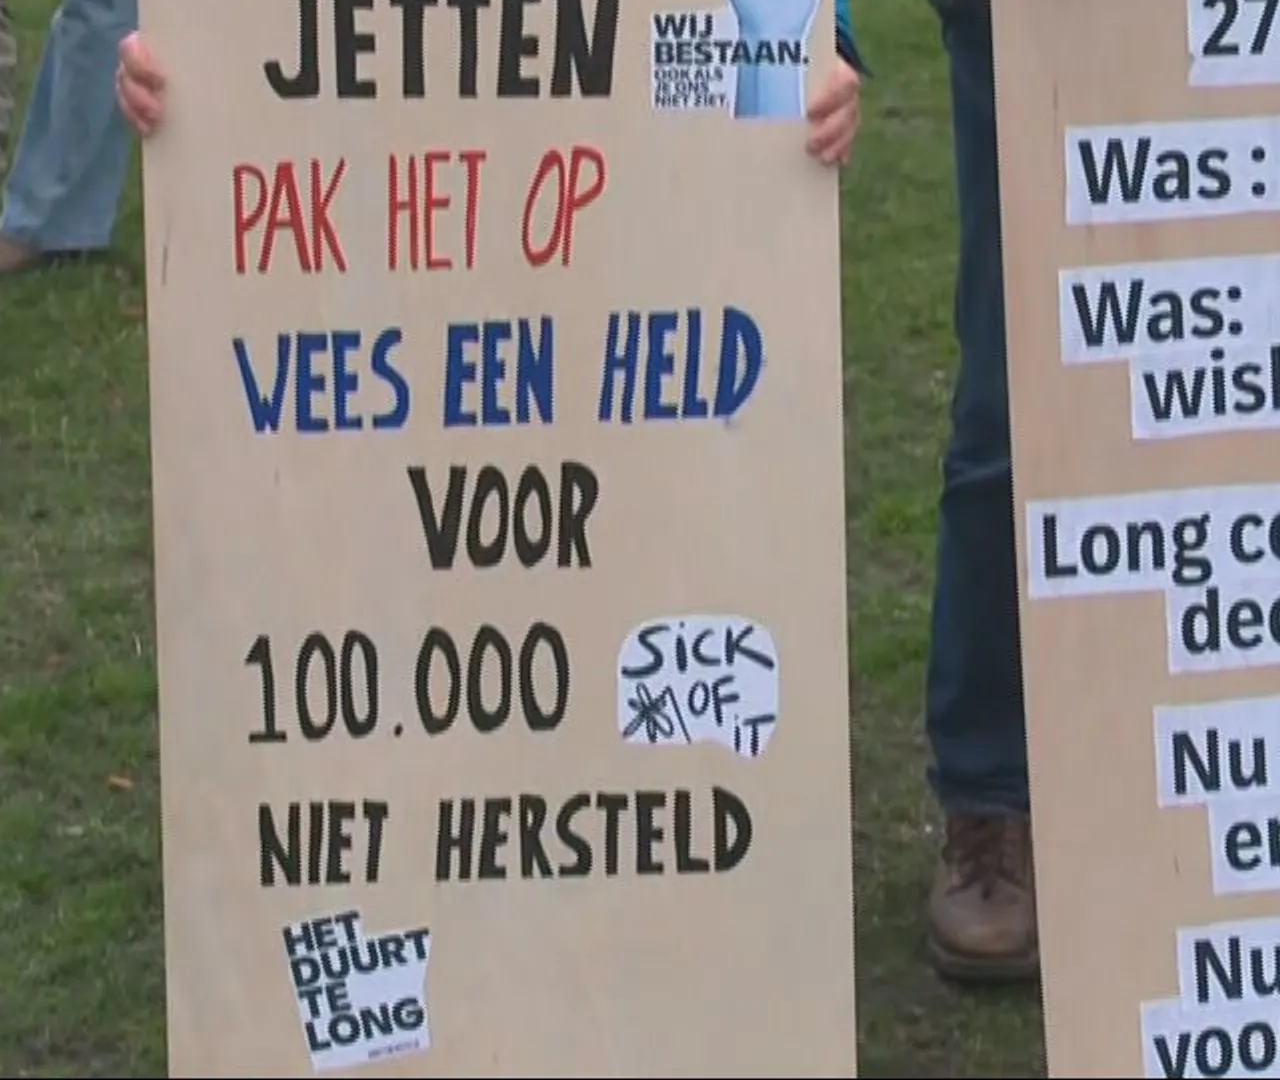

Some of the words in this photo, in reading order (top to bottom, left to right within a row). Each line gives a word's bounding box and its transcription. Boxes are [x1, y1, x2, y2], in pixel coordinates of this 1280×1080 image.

[654, 12, 714, 40] WIJ
[654, 40, 810, 66] BESTAAN.
[232, 157, 347, 275] PAK
[387, 149, 487, 272] HET
[522, 145, 606, 268] OP
[1072, 280, 1243, 348] Was:
[232, 327, 411, 435] WEES
[442, 314, 554, 428] EEN
[598, 306, 765, 425] HELD
[406, 461, 600, 571] VOOR
[1041, 513, 1213, 587] Long
[243, 621, 571, 744] 100.000
[687, 674, 741, 728] OF
[258, 799, 389, 887] NIET
[435, 786, 754, 882] HERSTELD
[283, 909, 360, 956] HET
[290, 926, 430, 987] DUURT
[298, 981, 352, 1018] TE
[305, 997, 425, 1052] LONG
